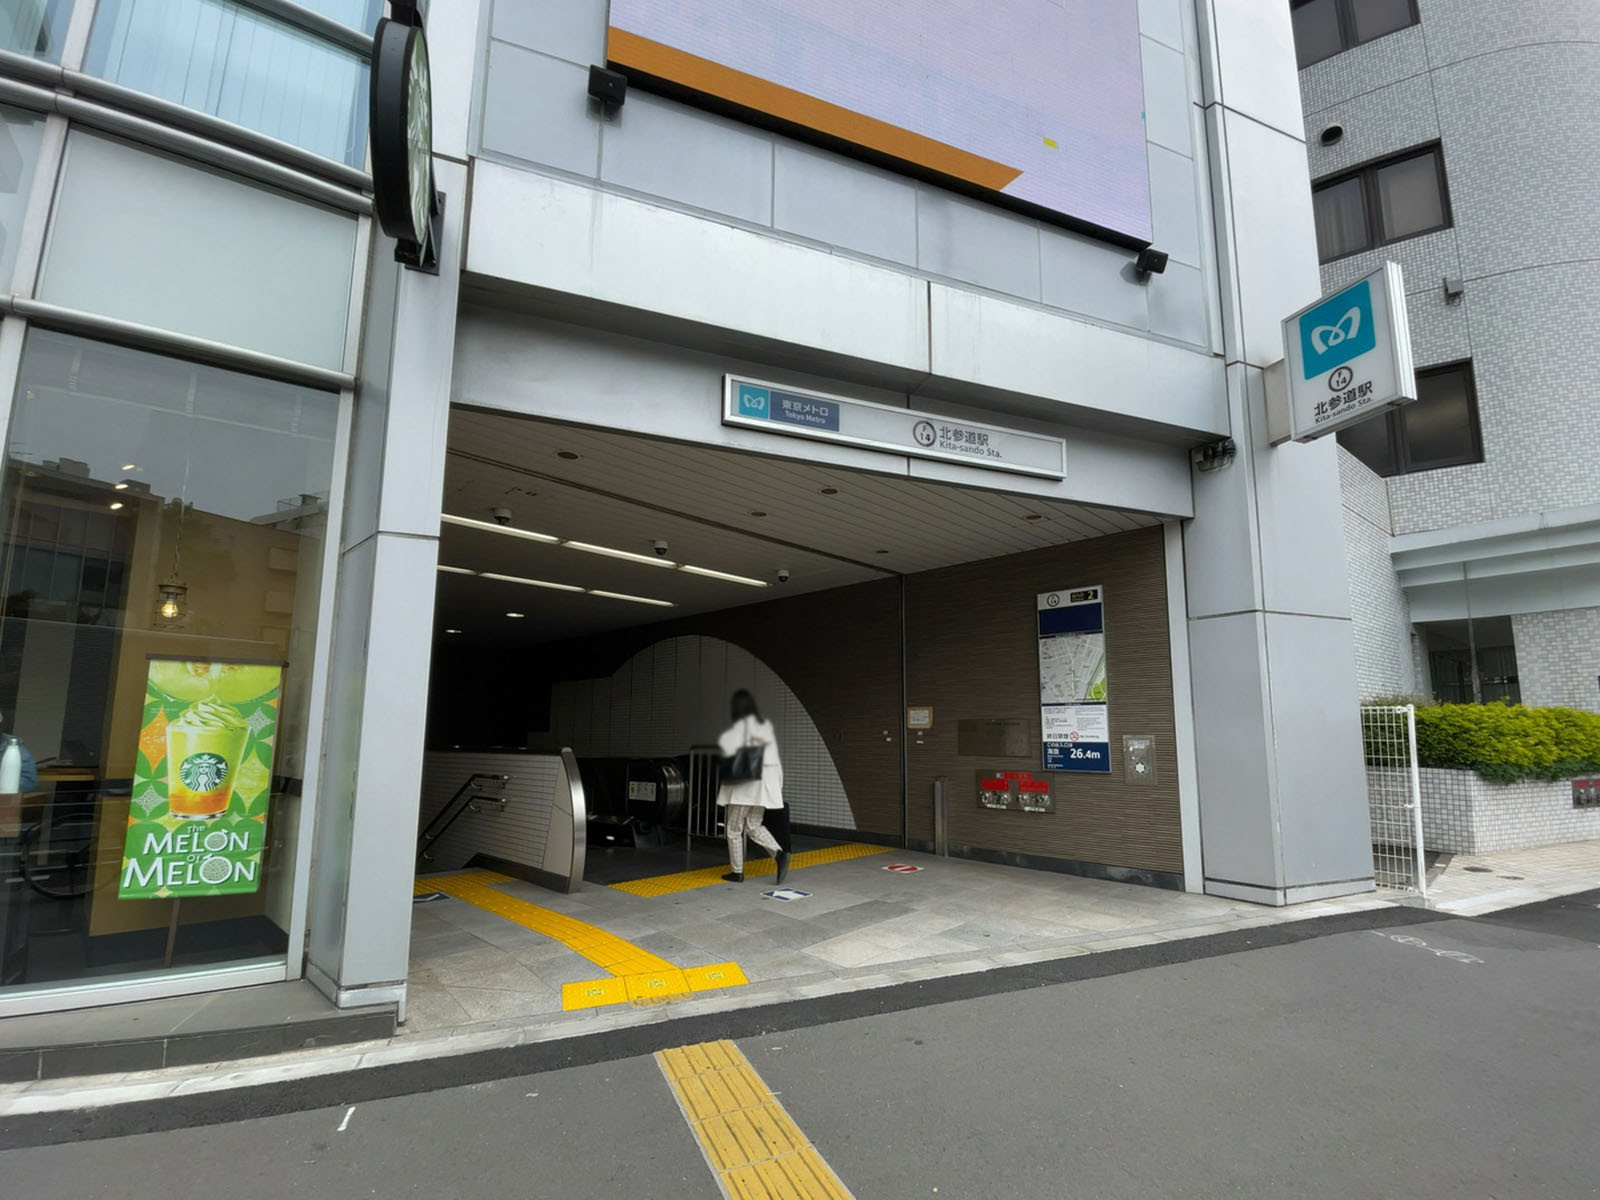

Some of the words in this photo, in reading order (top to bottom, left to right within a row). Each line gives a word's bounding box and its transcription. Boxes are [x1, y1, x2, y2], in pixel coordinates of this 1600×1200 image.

[1335, 377, 1347, 386] 14
[1314, 381, 1374, 416] 北参道駅
[782, 400, 829, 416] 東京メトロ
[1315, 403, 1356, 424] Kita-sando
[1358, 397, 1374, 407] Sta.
[785, 410, 805, 421] Tokyo
[806, 414, 826, 424] Metro
[922, 425, 928, 433] F
[939, 426, 990, 447] 北参道駅
[919, 432, 931, 442] 14
[939, 440, 985, 455] Kita-sando
[986, 447, 1003, 458] Sta.
[1087, 591, 1094, 600] 2
[1070, 748, 1101, 759] 26.4m
[187, 824, 206, 834] The
[143, 828, 250, 855] MELON
[123, 855, 256, 888] MELON
